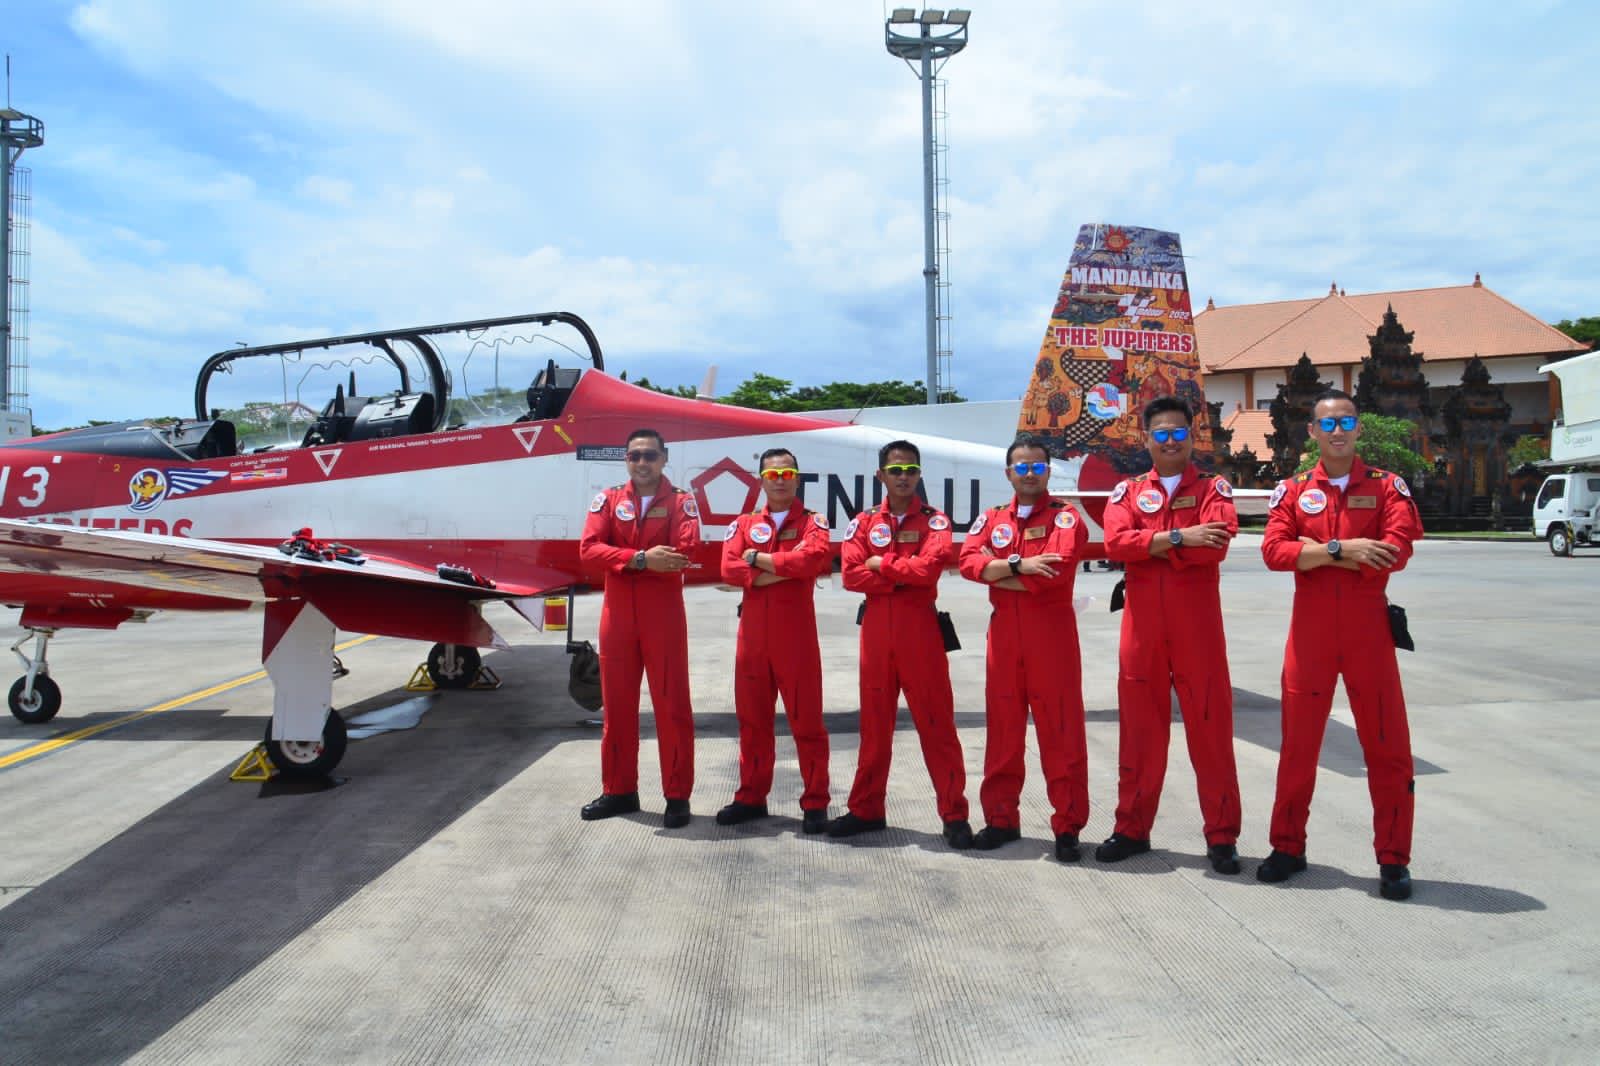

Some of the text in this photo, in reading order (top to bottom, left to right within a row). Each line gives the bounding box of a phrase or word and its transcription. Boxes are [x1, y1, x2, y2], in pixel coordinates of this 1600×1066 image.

[1071, 267, 1184, 289] MANDALIKA
[1055, 327, 1193, 353] THE JUPITERS
[567, 414, 575, 423] 2
[113, 464, 120, 473] 2
